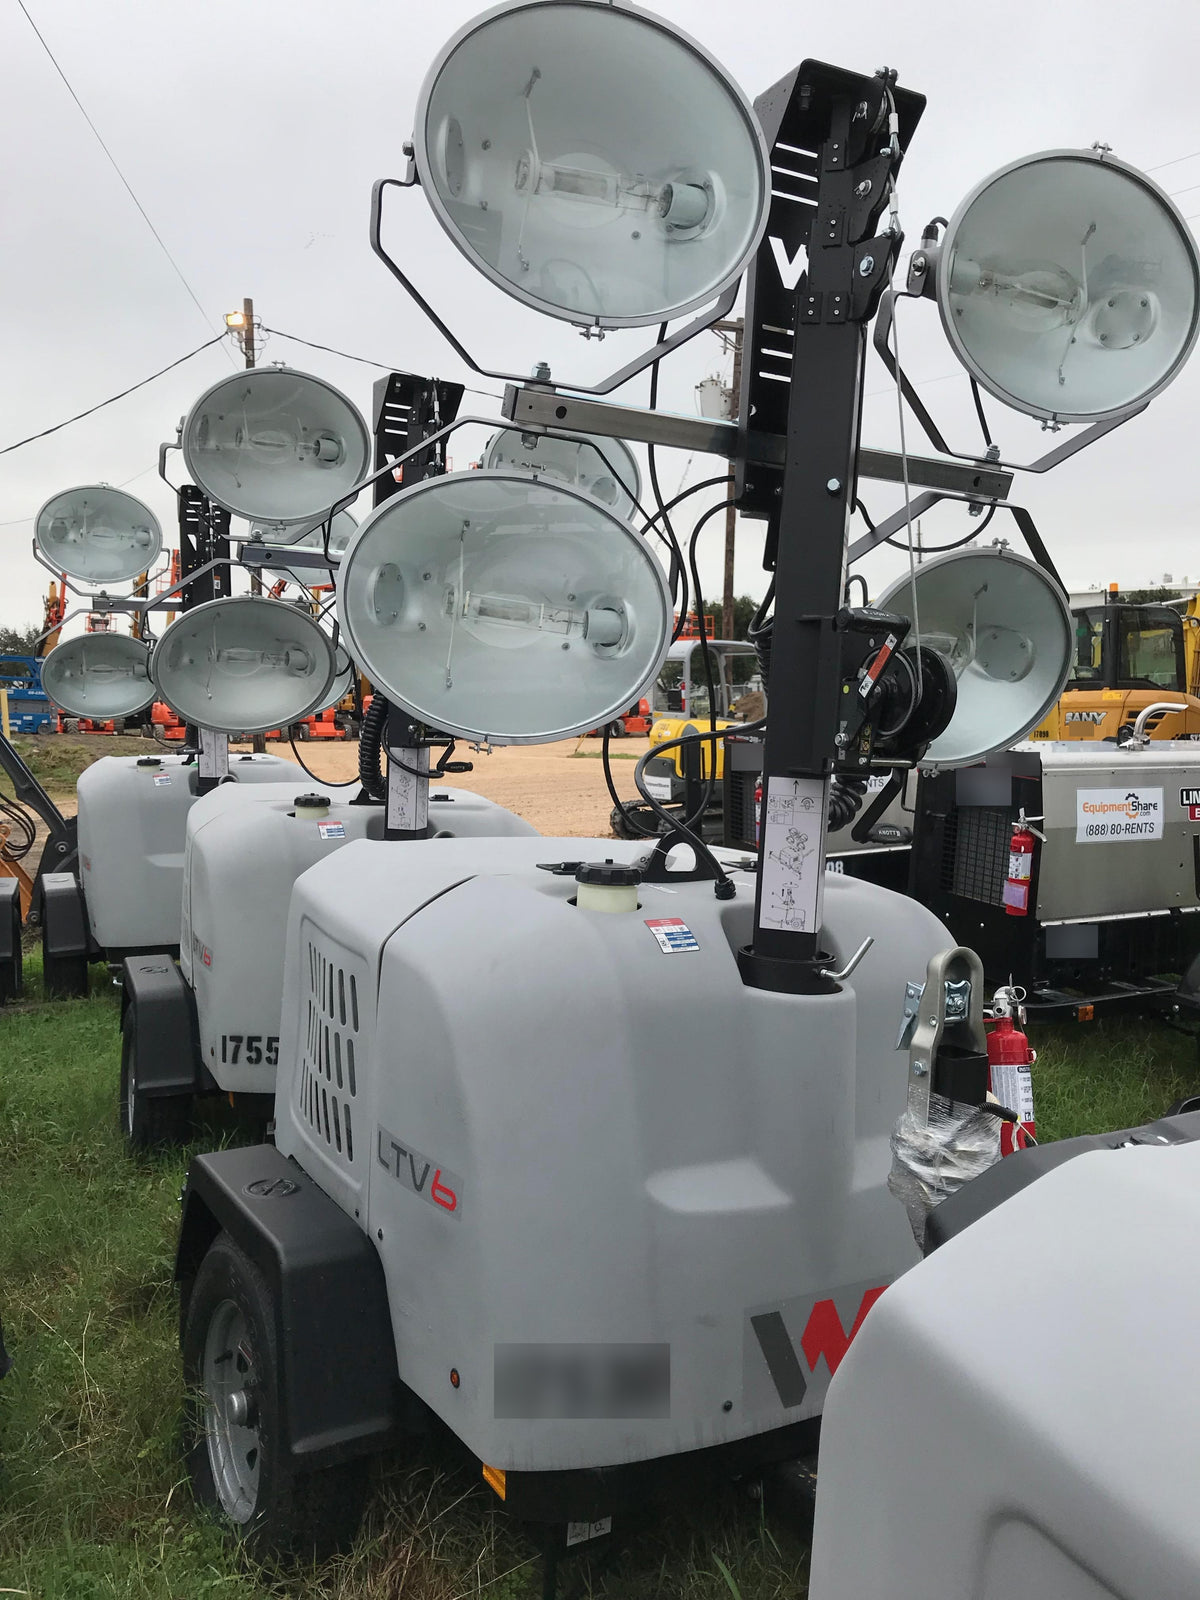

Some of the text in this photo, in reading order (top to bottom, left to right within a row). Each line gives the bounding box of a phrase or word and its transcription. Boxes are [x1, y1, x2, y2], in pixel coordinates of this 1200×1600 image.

[1065, 711, 1107, 726] SANY
[1082, 800, 1158, 815] EquipmentShare
[1085, 822, 1155, 837] (888) 80-RENTS
[378, 1130, 457, 1211] LTV6
